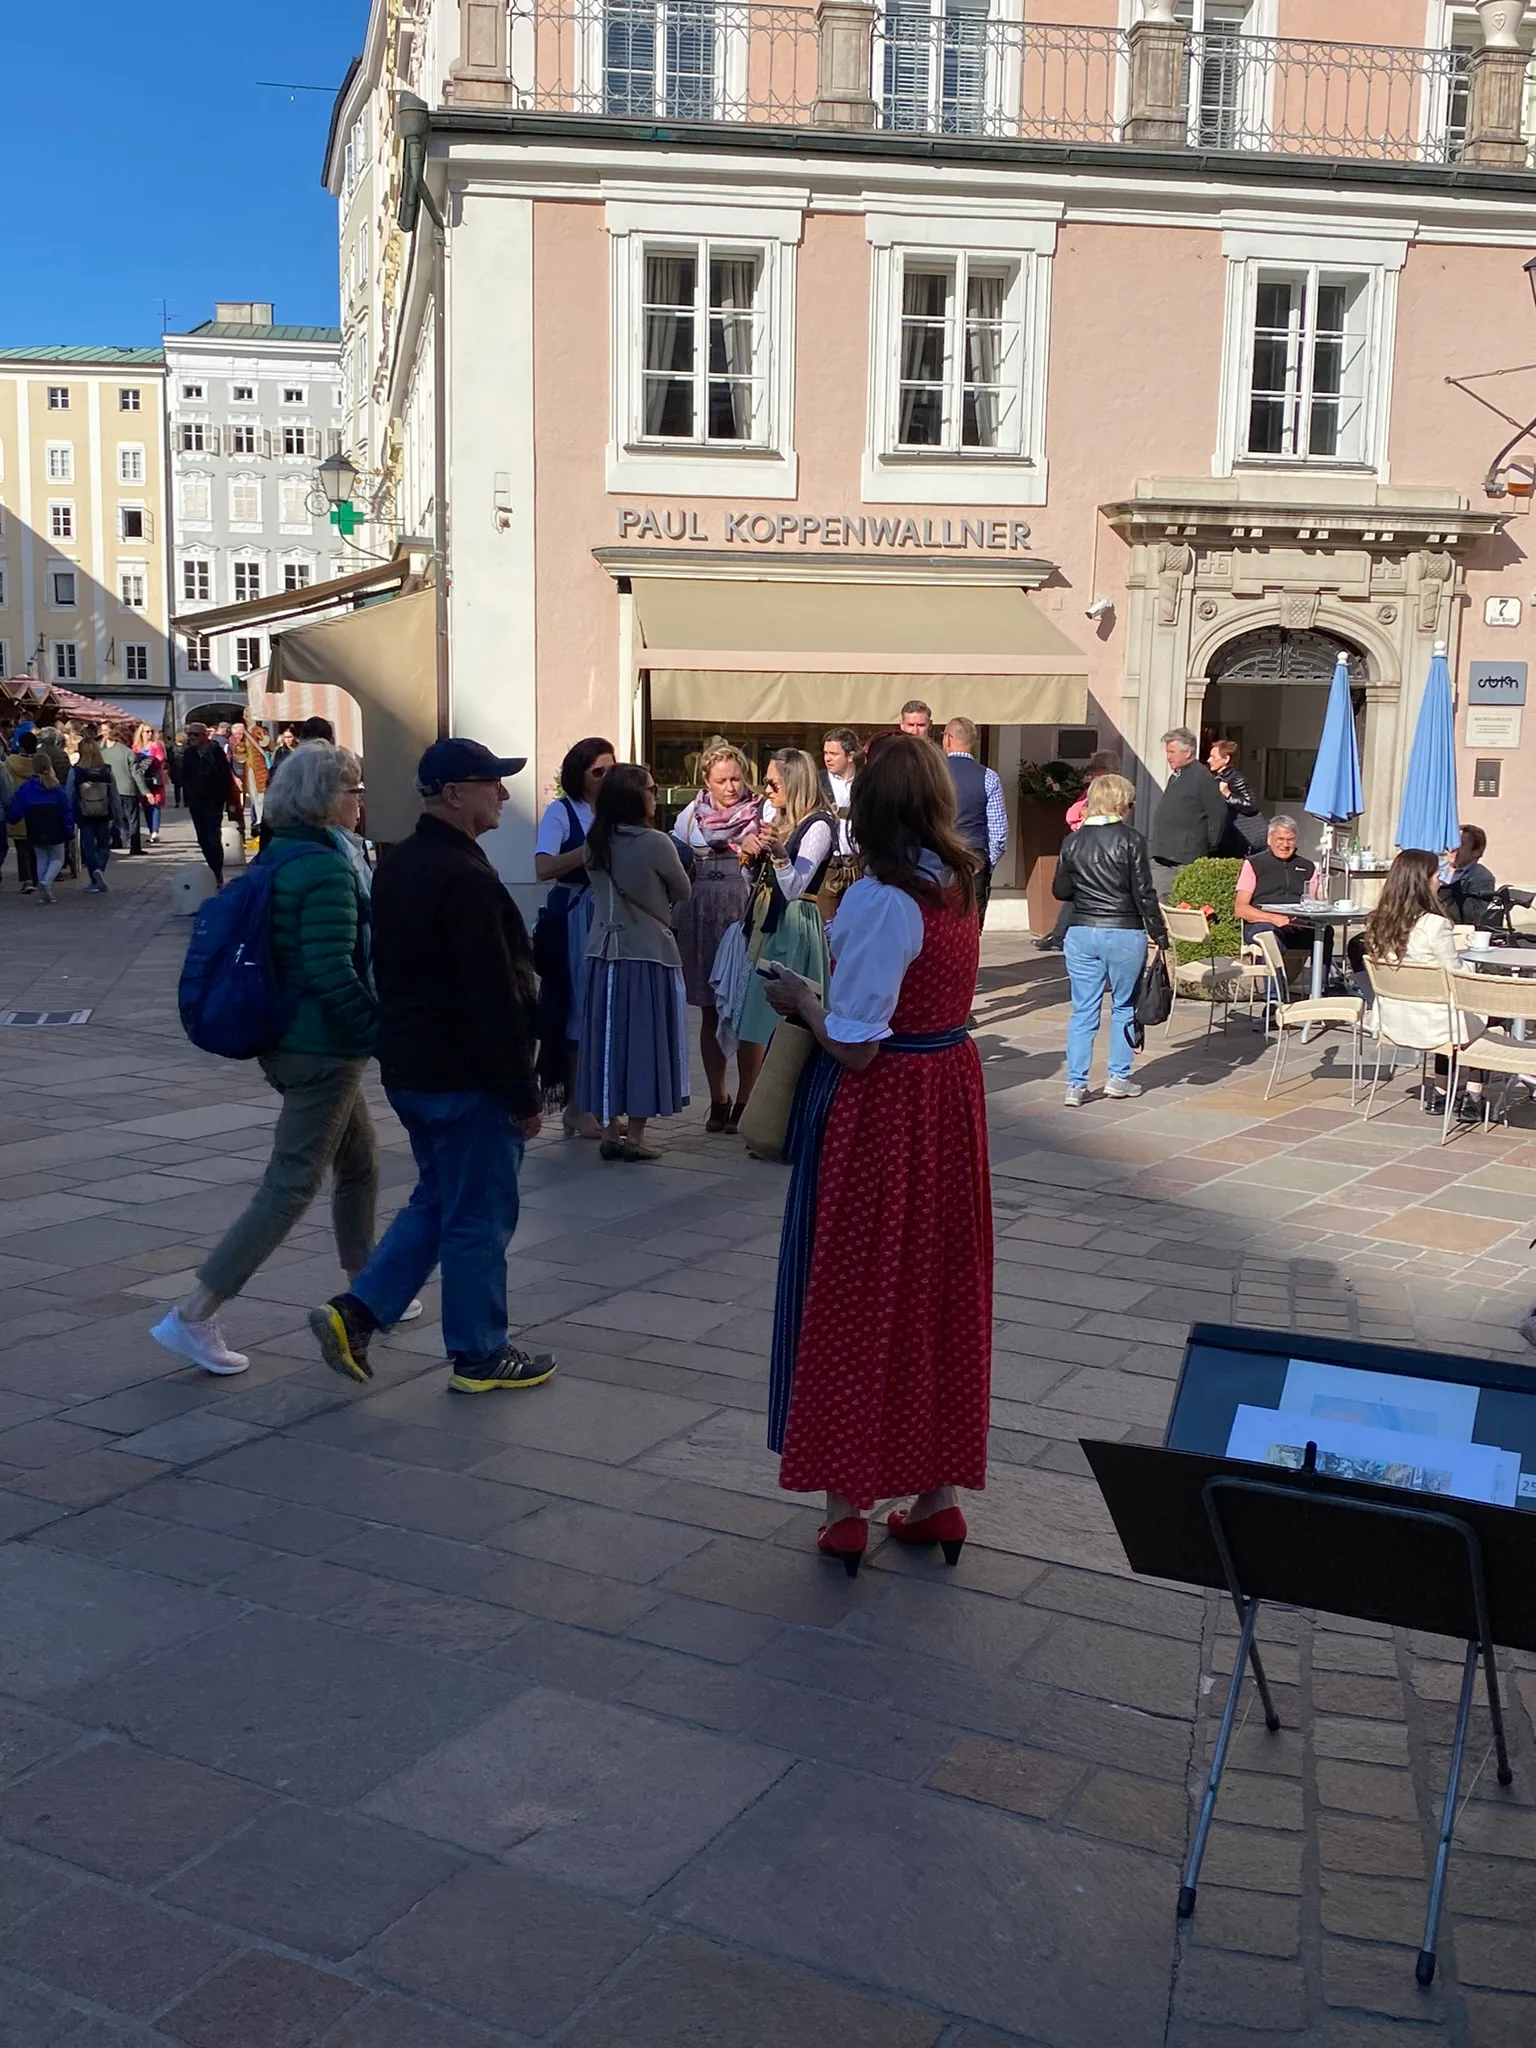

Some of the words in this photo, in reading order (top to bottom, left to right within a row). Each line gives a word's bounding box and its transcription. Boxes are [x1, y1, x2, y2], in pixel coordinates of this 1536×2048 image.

[617, 507, 708, 542] PAUL
[723, 511, 1033, 550] KOPPENWALLNER
[1499, 599, 1509, 617] 7
